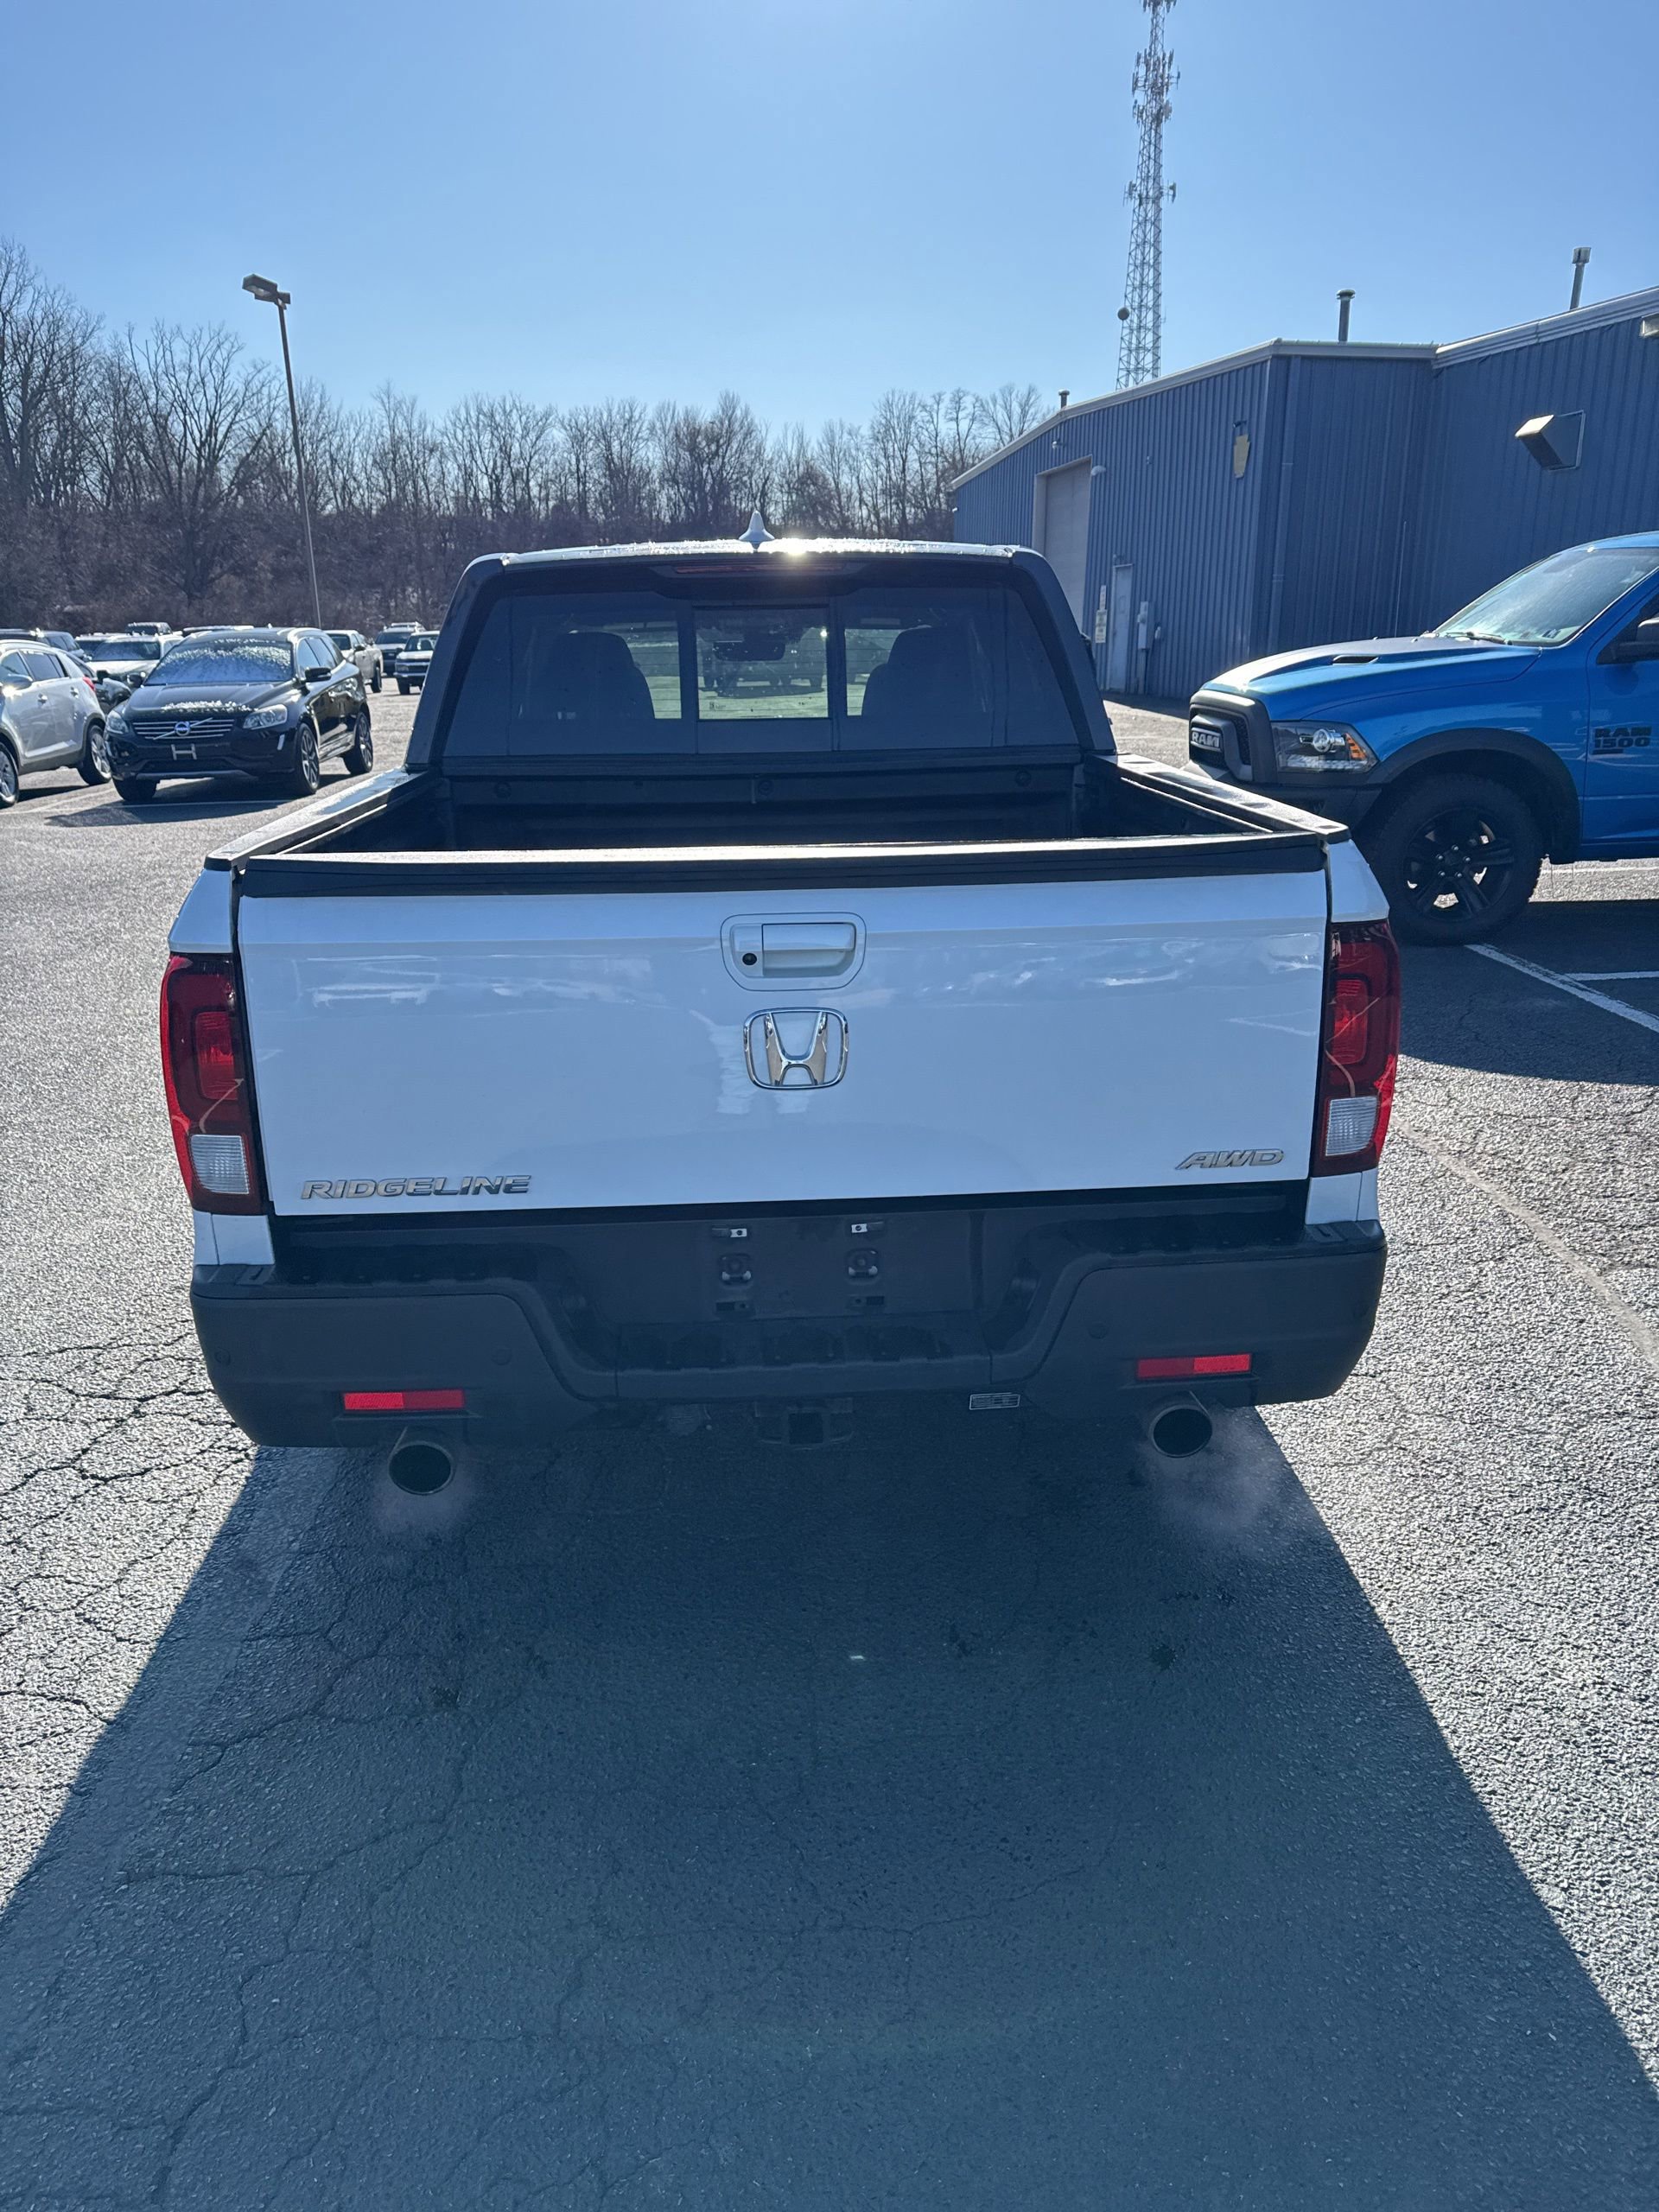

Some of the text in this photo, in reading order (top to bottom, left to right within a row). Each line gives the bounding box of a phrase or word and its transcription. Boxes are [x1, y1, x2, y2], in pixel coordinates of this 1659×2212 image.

[1192, 731, 1219, 747] RAM
[1175, 1148, 1284, 1170] AWD
[301, 1175, 531, 1199] RIDGELINE
